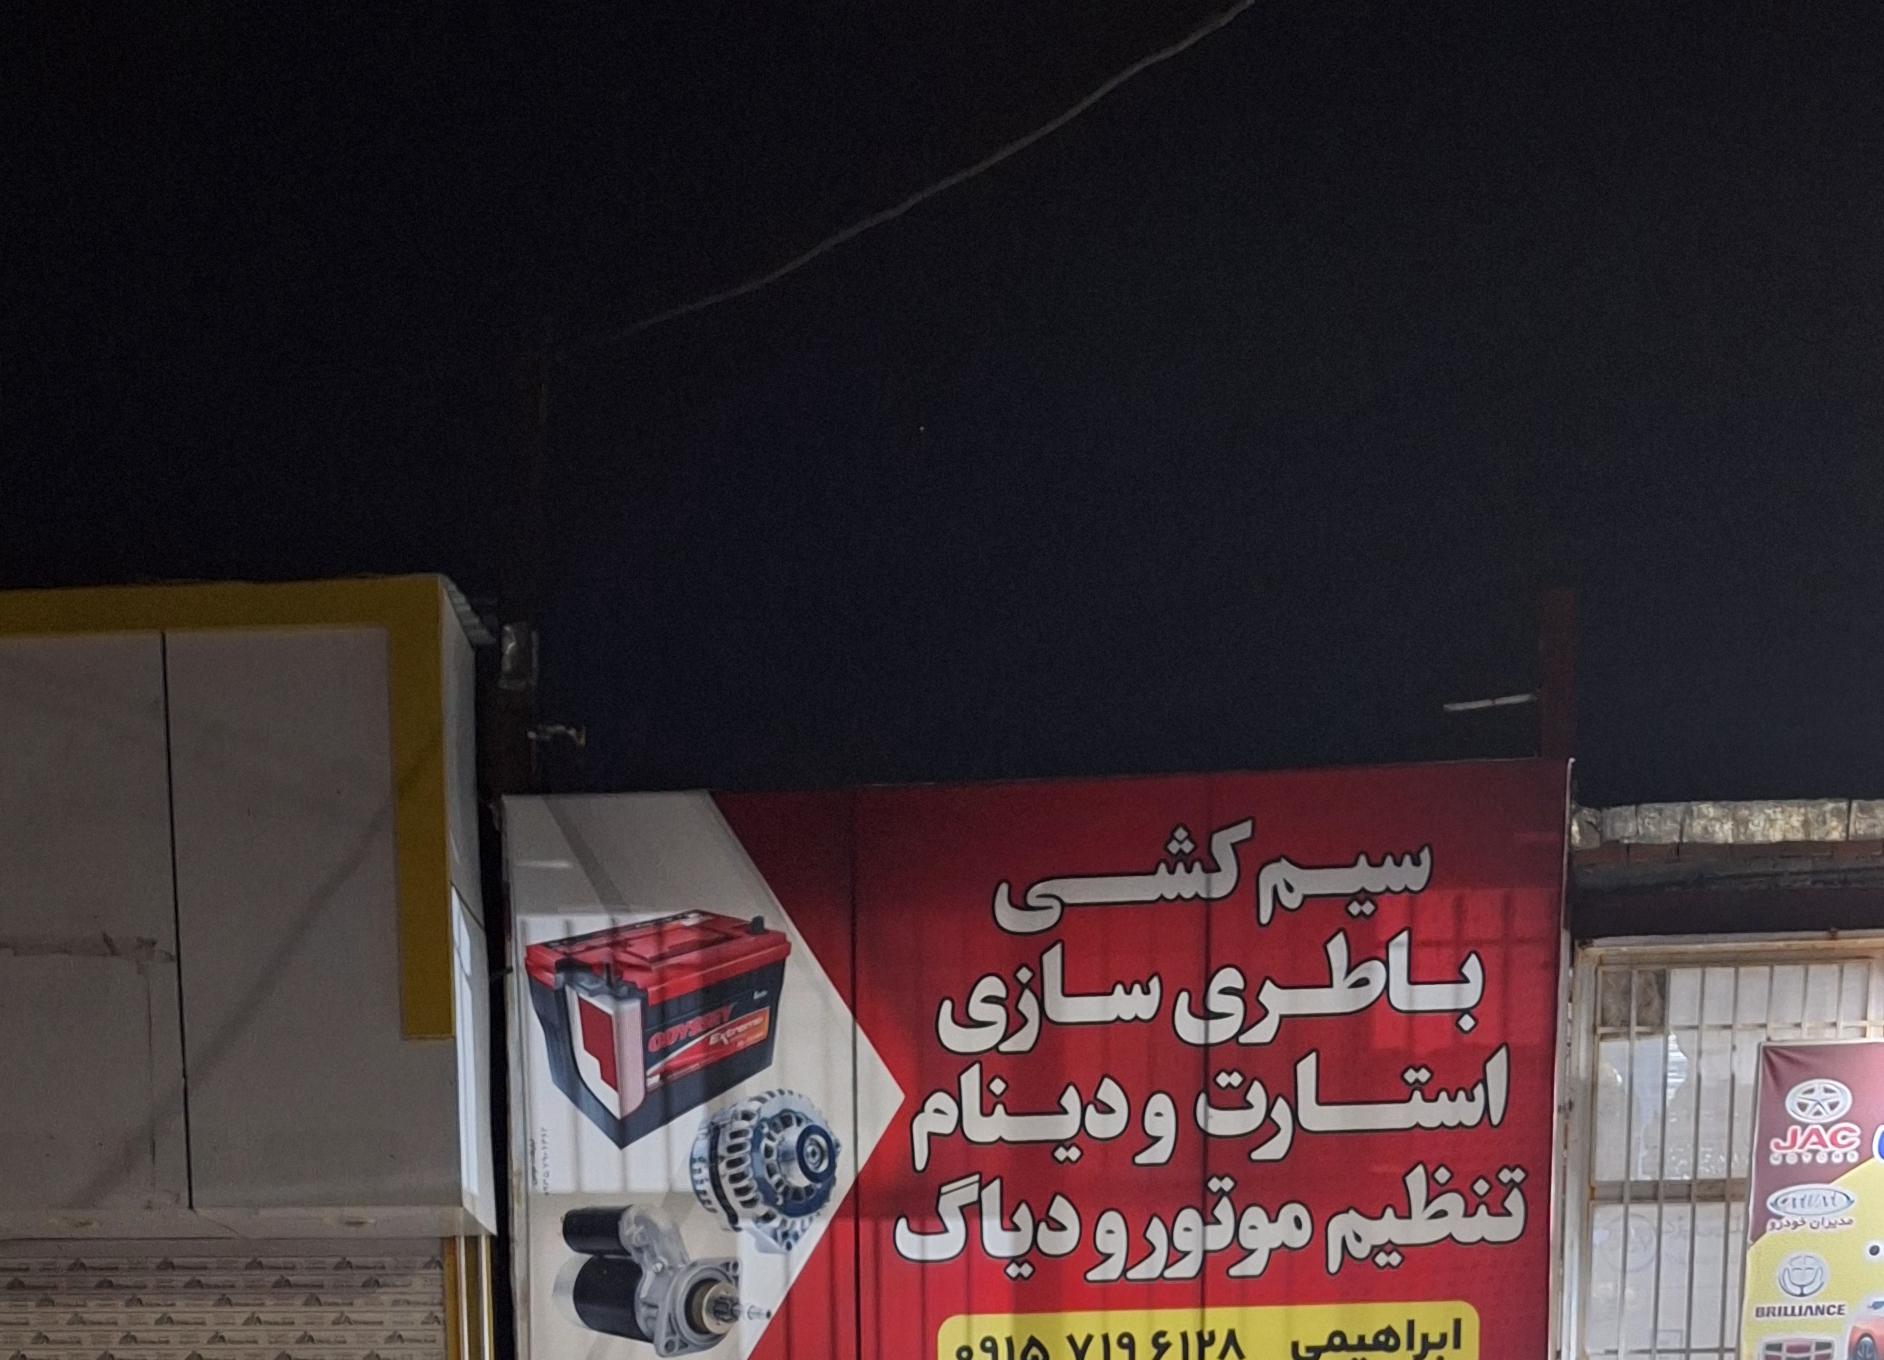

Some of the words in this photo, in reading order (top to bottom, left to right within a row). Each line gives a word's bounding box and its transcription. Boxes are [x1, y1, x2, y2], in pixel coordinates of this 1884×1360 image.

[993, 817, 1255, 934] کشی
[1256, 844, 1433, 926] سیم
[937, 939, 1162, 1054] سازی
[1173, 928, 1484, 1046] باطری
[911, 1061, 1130, 1172] دینام
[1132, 1090, 1179, 1165] و
[1196, 1044, 1511, 1161] استارت
[1770, 1123, 1860, 1153] JAC
[893, 1173, 1082, 1280] دیاگ
[1326, 1163, 1527, 1275] تنظیم
[1755, 1304, 1846, 1318] BRILLIANCE
